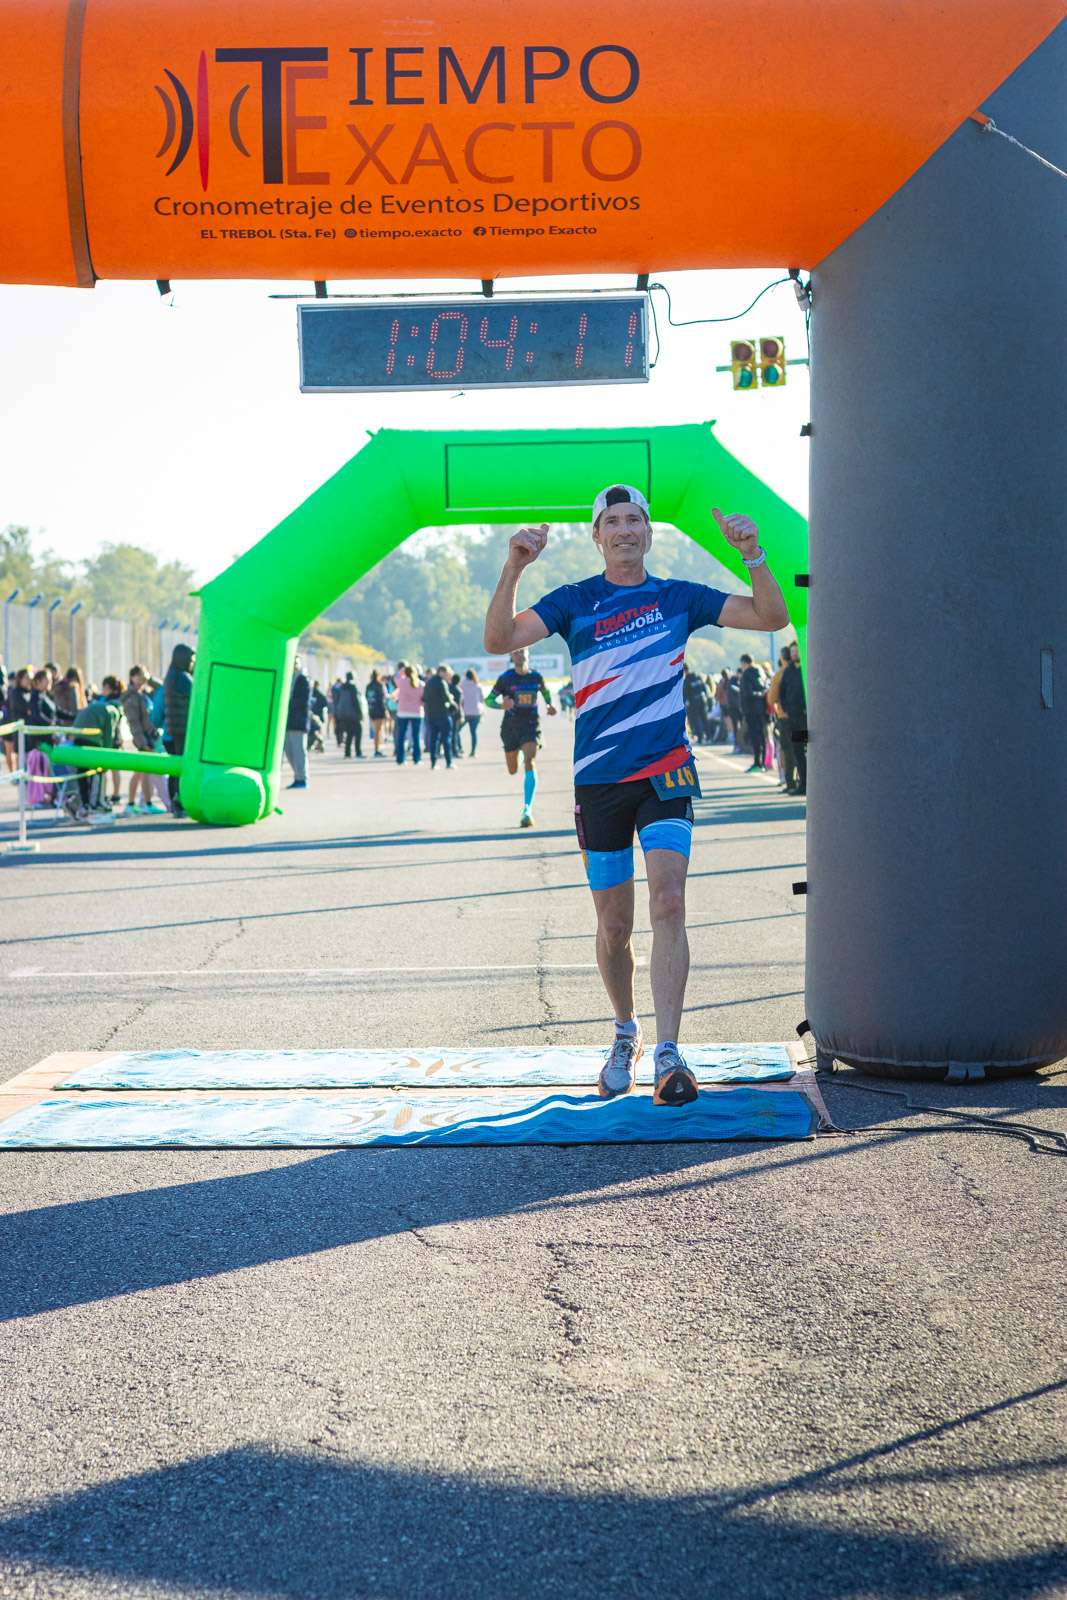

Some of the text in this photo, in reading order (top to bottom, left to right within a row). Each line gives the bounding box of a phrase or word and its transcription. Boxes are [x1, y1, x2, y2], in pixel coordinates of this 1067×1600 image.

[153, 192, 641, 219] Cronometraje de Eventos Deportivos
[201, 228, 337, 240] EL TREBOL (Sta. Fe)
[359, 226, 463, 239] tiempo.exacto
[488, 225, 598, 238] Tiempo Exacto
[598, 623, 668, 650] ARGENTINA
